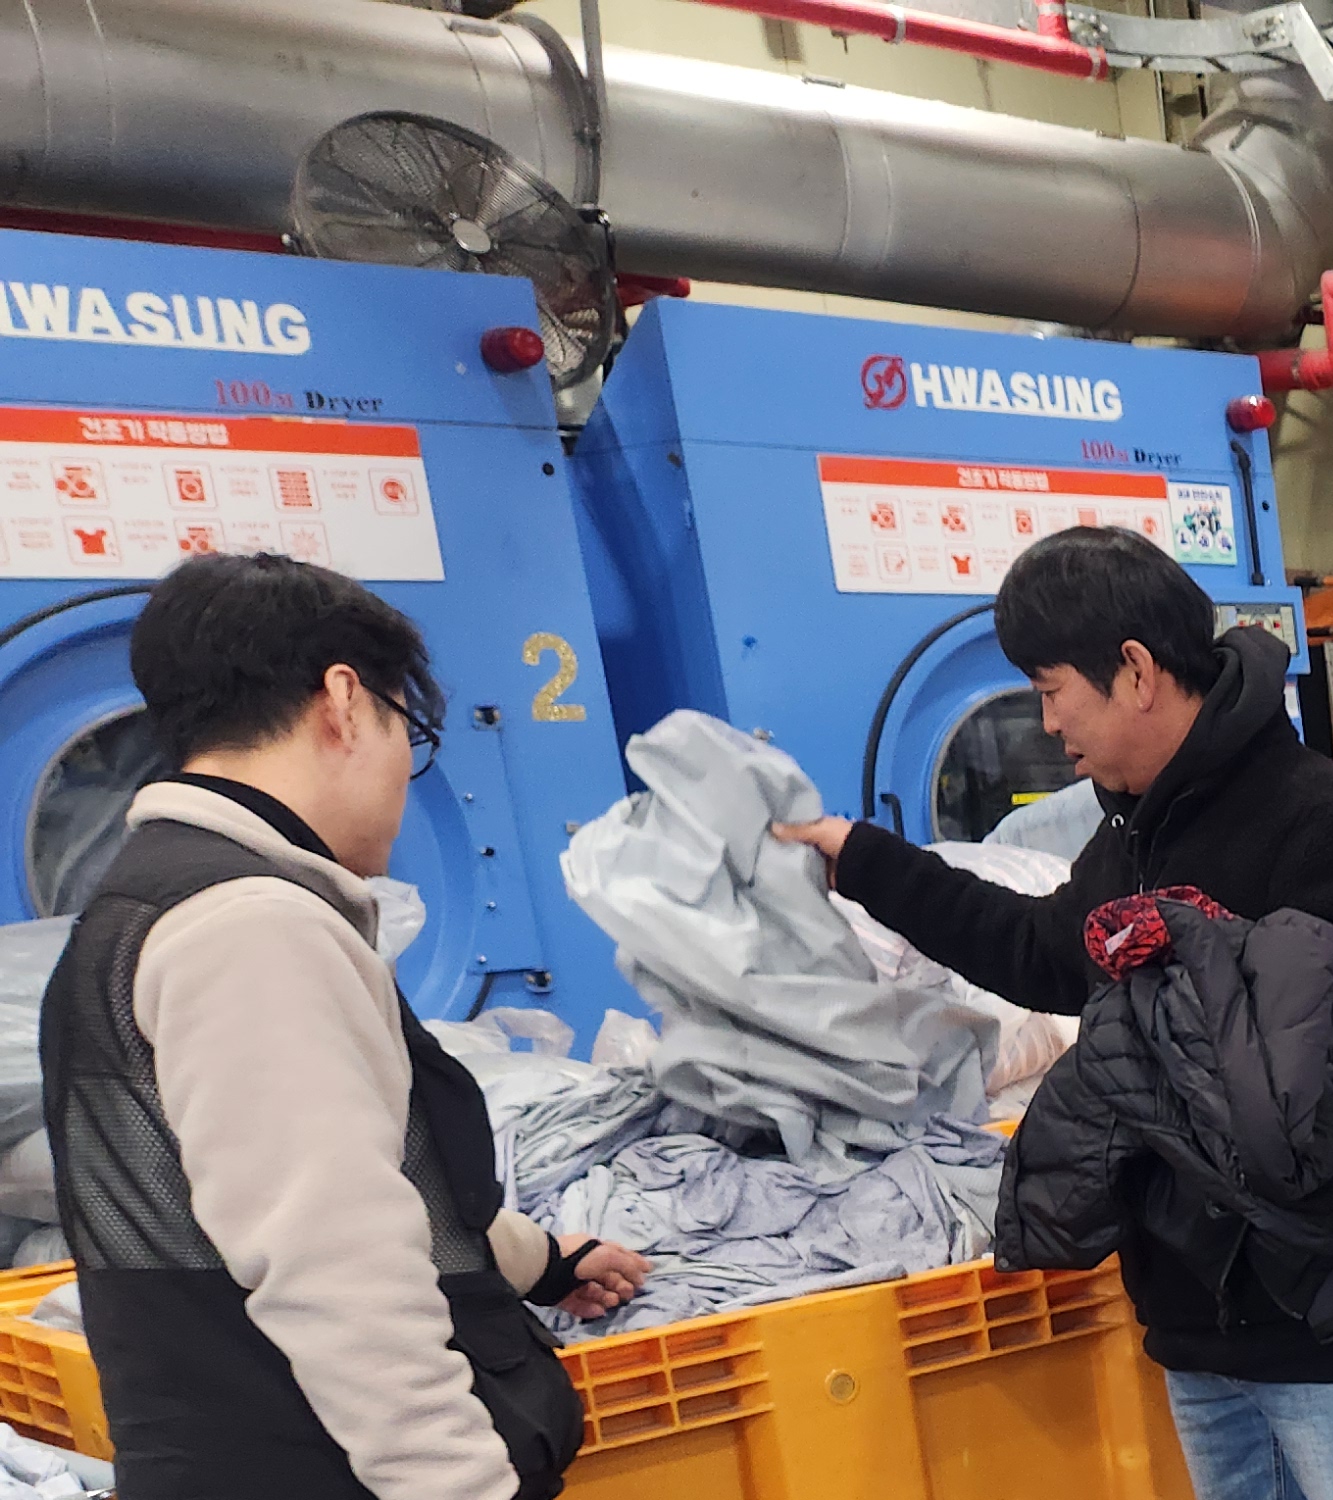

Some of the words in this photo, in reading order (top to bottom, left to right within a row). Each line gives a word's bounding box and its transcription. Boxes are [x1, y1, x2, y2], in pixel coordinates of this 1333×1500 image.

[304, 390, 383, 418] Dryer
[910, 362, 1123, 422] HWASUNG
[78, 417, 145, 442] 건조기
[1132, 446, 1182, 470] Dryer
[956, 466, 998, 490] 건조기
[522, 632, 587, 722] 2
